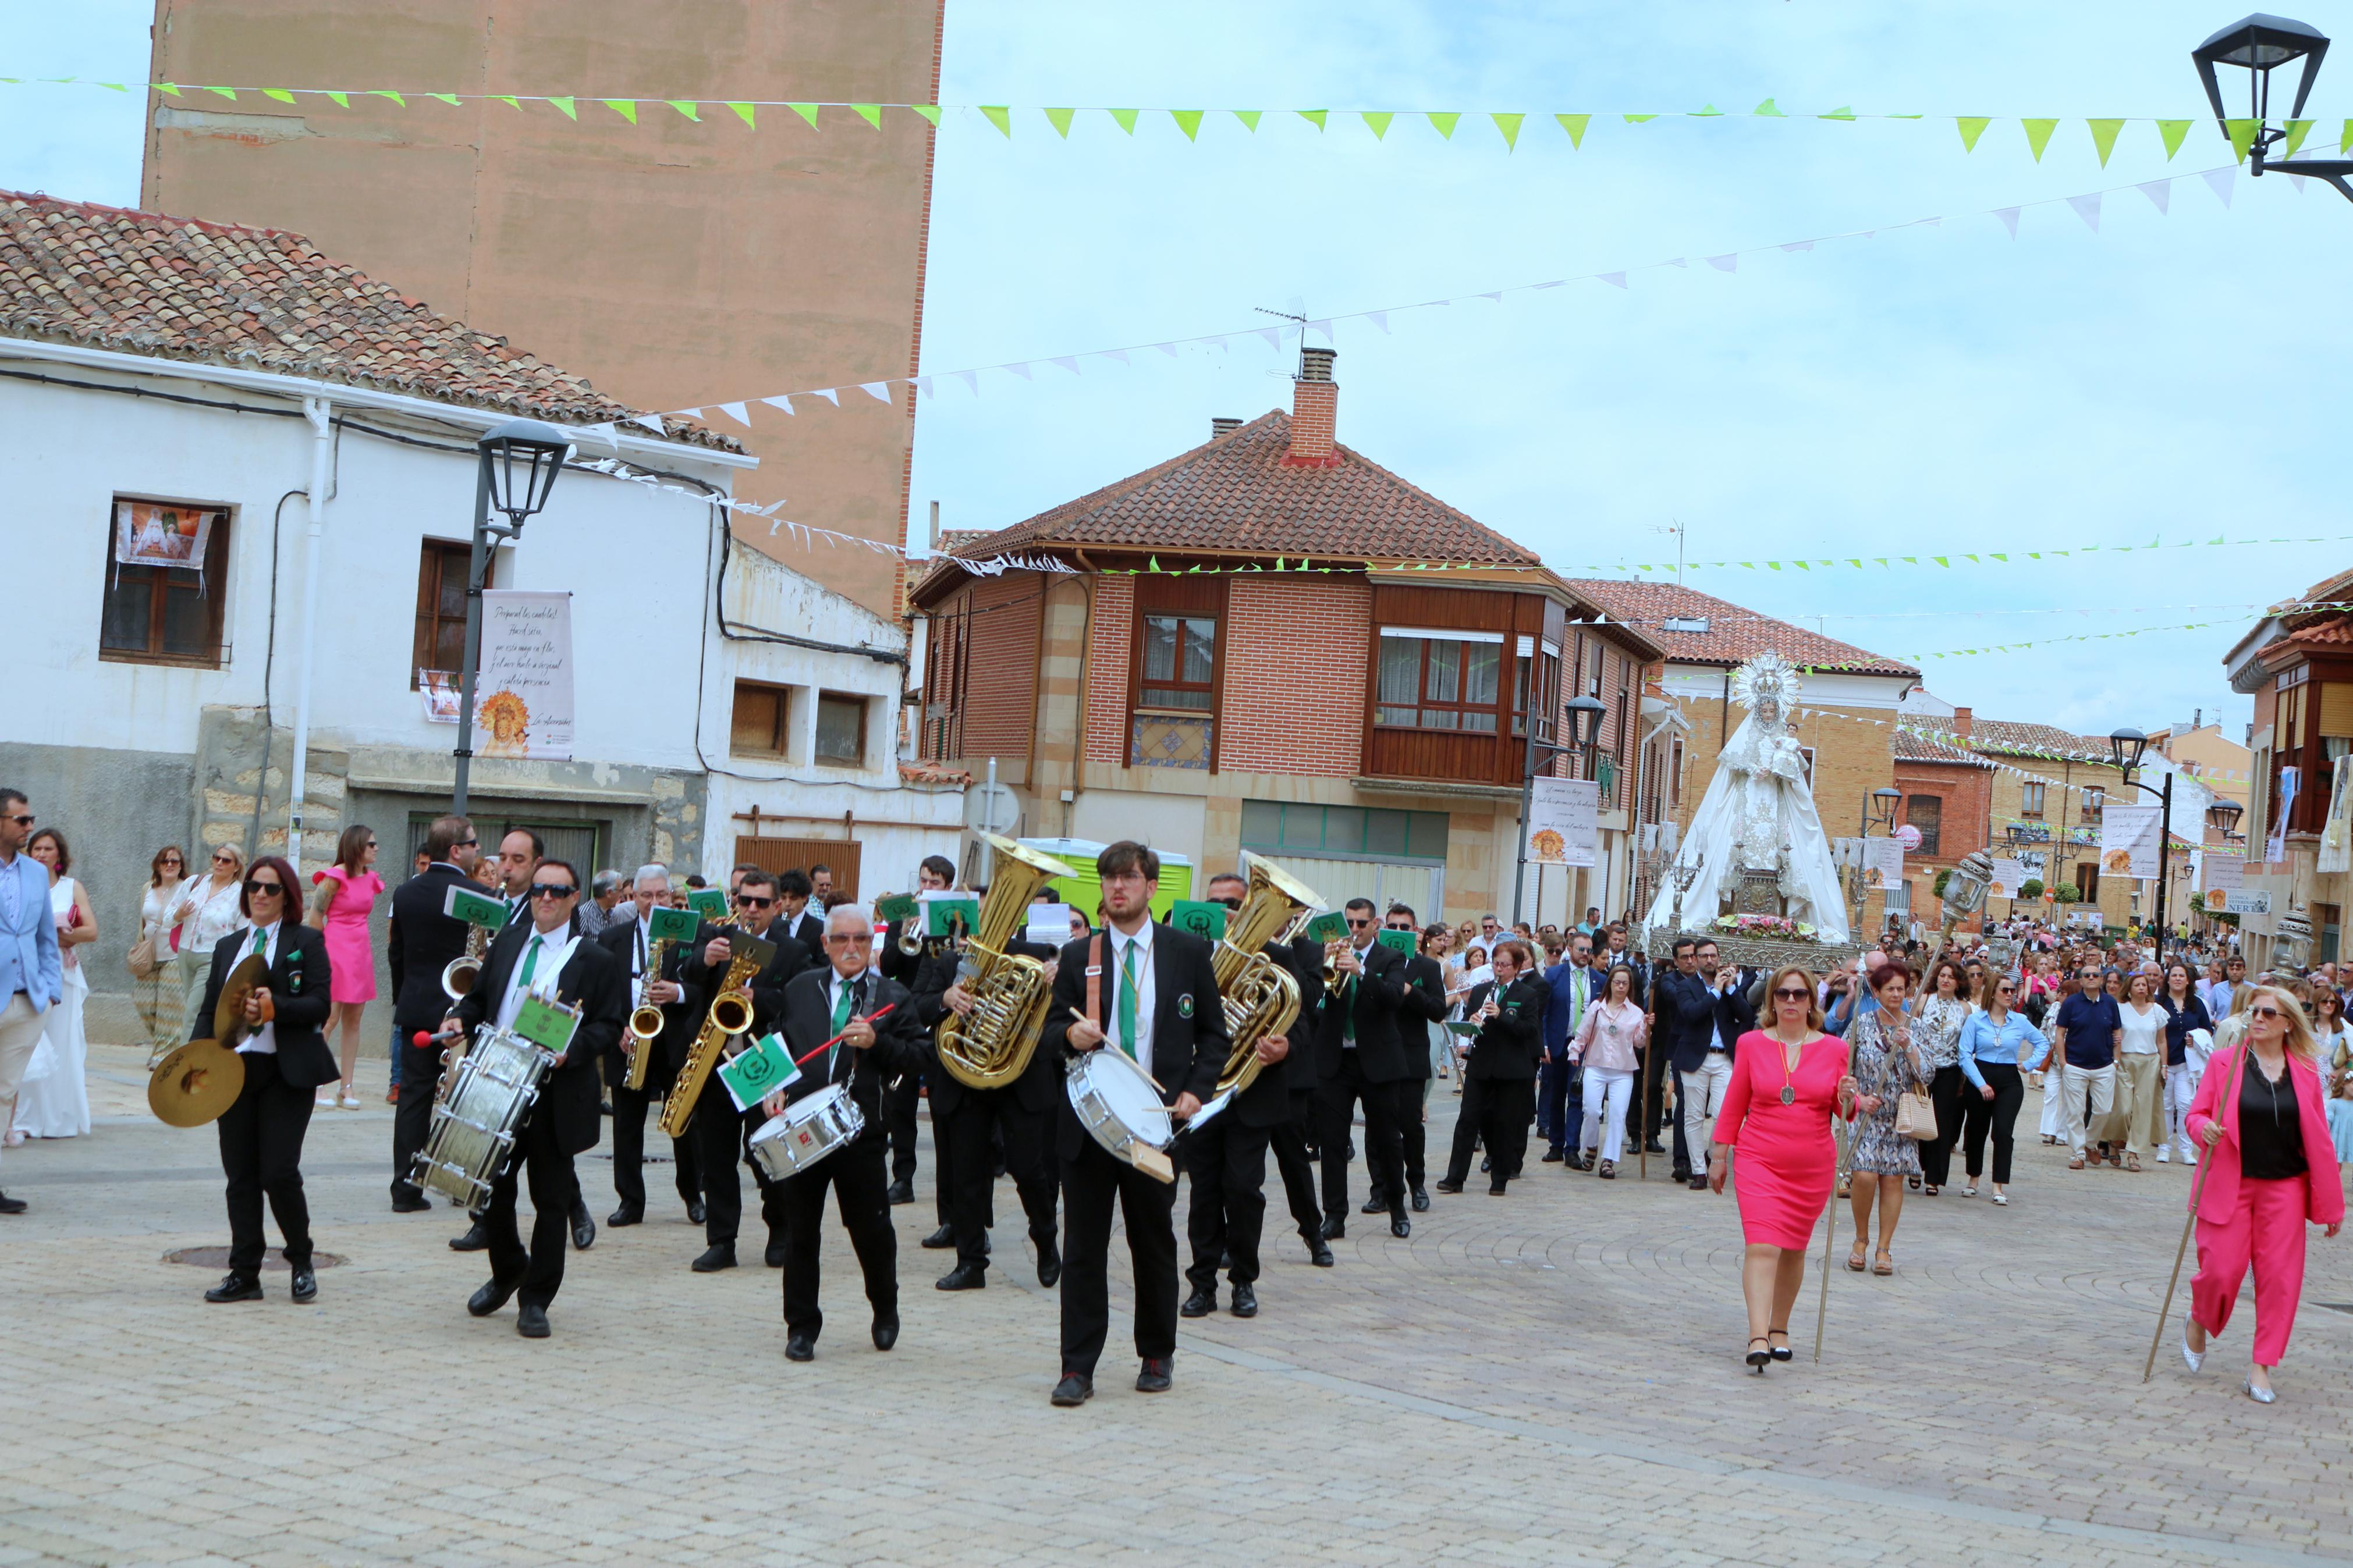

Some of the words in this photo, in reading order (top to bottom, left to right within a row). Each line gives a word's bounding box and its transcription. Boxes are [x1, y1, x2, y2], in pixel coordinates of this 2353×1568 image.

[495, 606, 523, 620] Preparad
[531, 606, 558, 619] candelas!
[508, 623, 529, 636] Haced
[528, 626, 542, 636] sitio,
[494, 645, 503, 660] que
[518, 645, 531, 657] mayo
[489, 661, 495, 674] y
[496, 657, 505, 669] el
[516, 657, 531, 669] huele
[538, 658, 563, 676] virginal
[496, 678, 503, 691] y
[523, 677, 551, 688] presencia
